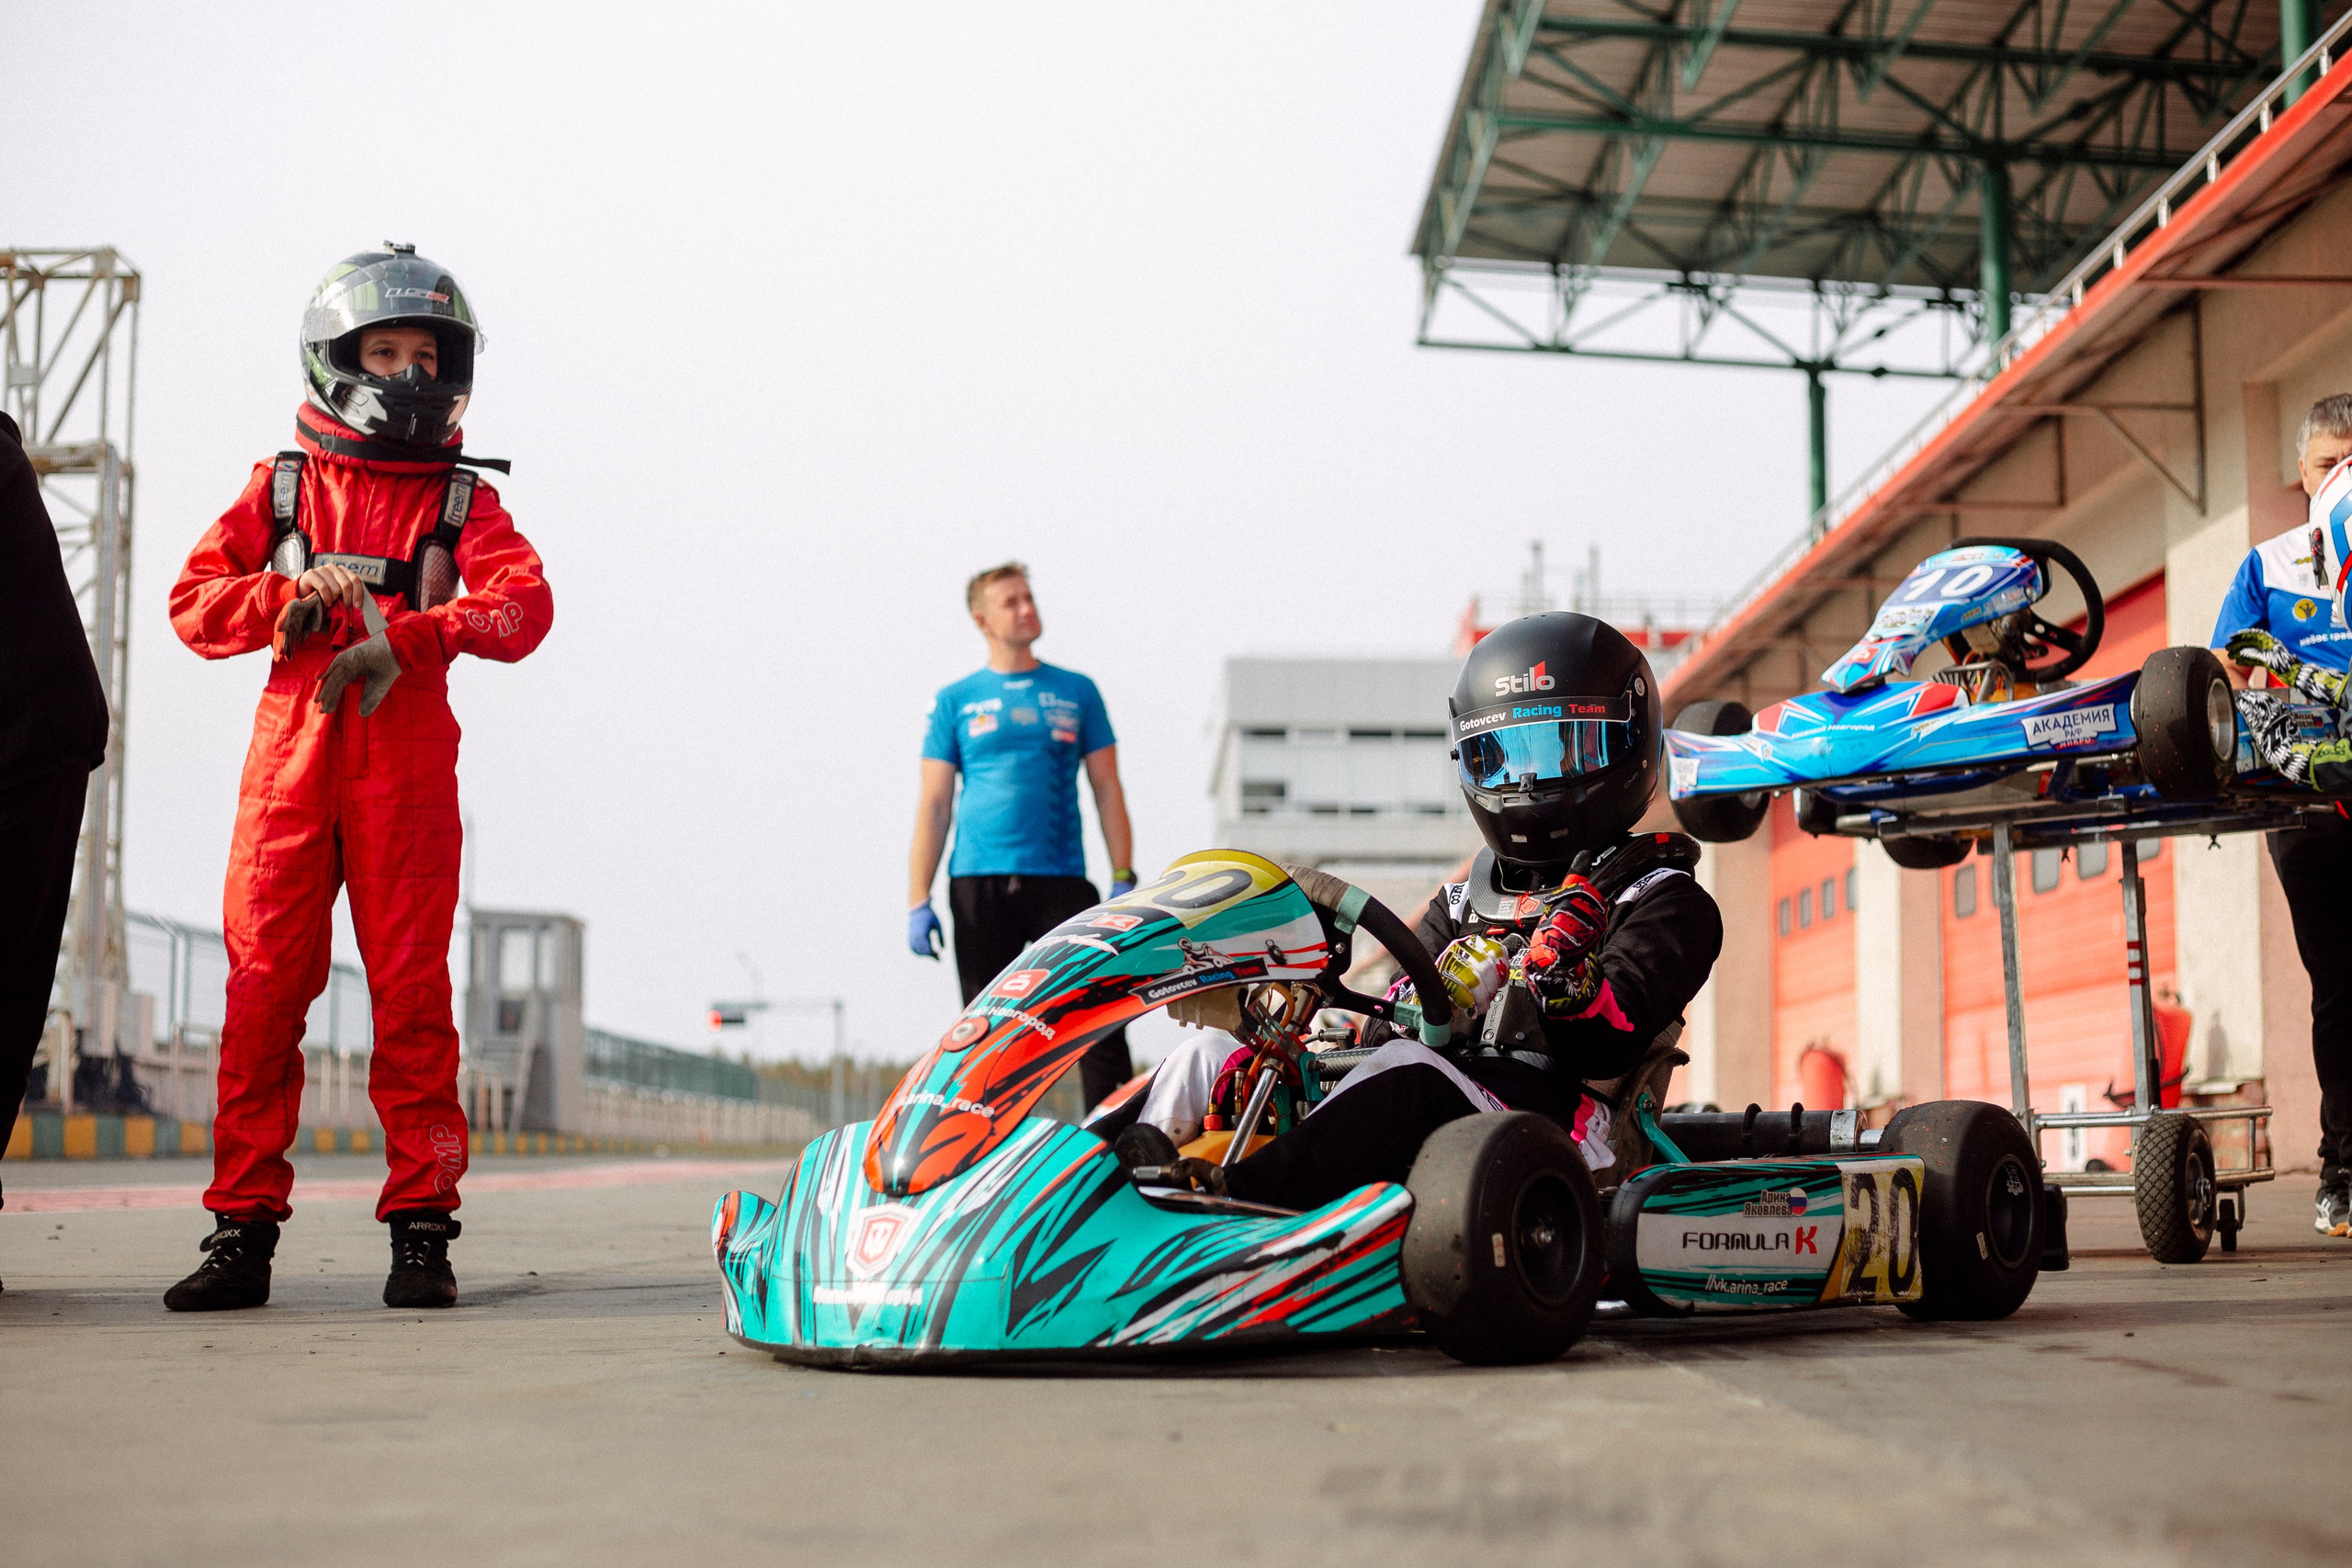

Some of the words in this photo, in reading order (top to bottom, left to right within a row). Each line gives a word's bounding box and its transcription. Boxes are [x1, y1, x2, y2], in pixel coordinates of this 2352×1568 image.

[447, 485, 468, 524] freem
[1903, 564, 1994, 603] 10
[1494, 660, 1555, 697] Stilo
[1459, 711, 1507, 731] Gotovcev
[1512, 704, 1562, 719] Racing
[1568, 703, 1606, 715] Team
[2032, 707, 2111, 736] АКАДЕМИЯ
[1148, 976, 1198, 999] Gotovcev
[1198, 969, 1236, 985] Racing
[1682, 1232, 1790, 1250] FORMULA
[1794, 1225, 1818, 1255] K
[1845, 1167, 1919, 1297] 20
